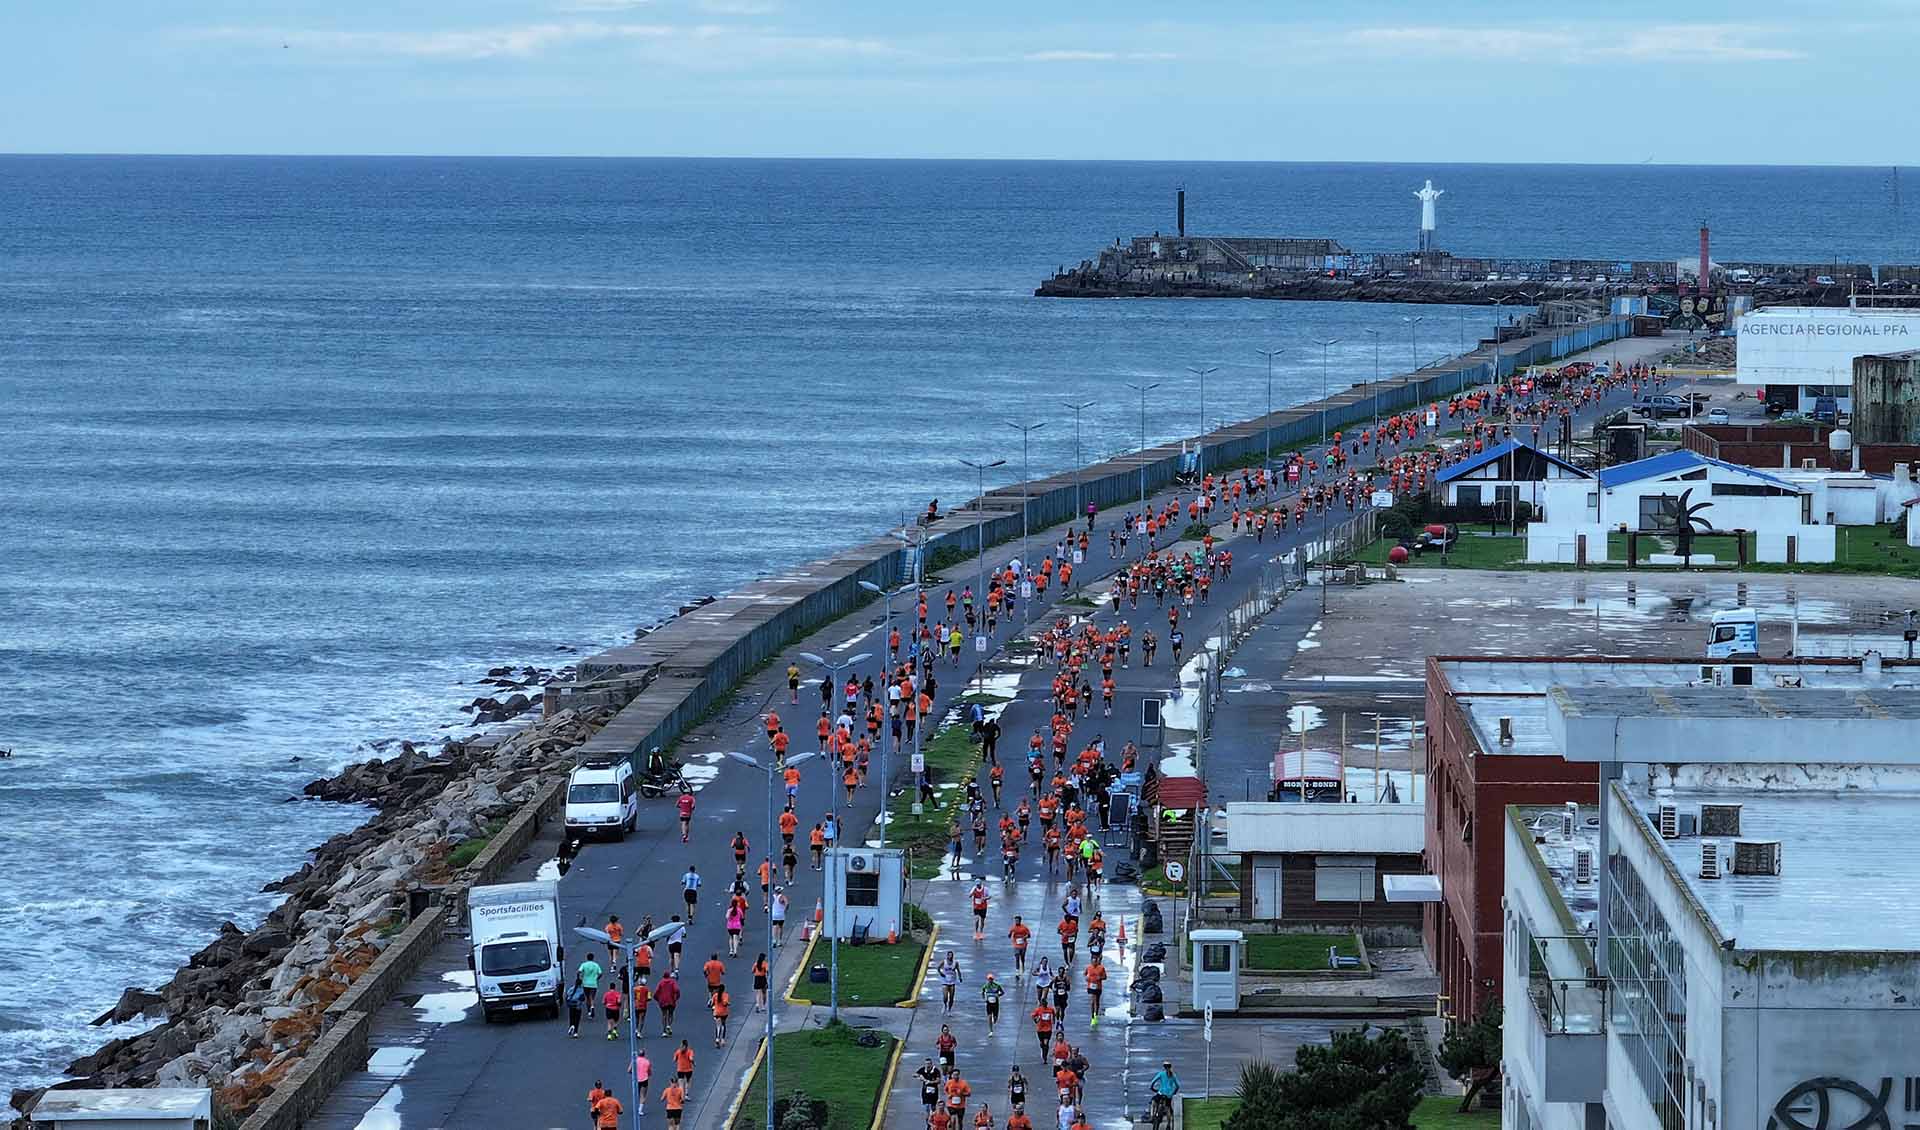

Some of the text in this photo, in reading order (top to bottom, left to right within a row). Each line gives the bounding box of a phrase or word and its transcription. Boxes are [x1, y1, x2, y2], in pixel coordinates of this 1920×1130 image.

[1741, 323, 1909, 336] AGENCIA REGIONAL PFA
[479, 903, 545, 917] Sportsfacilities
